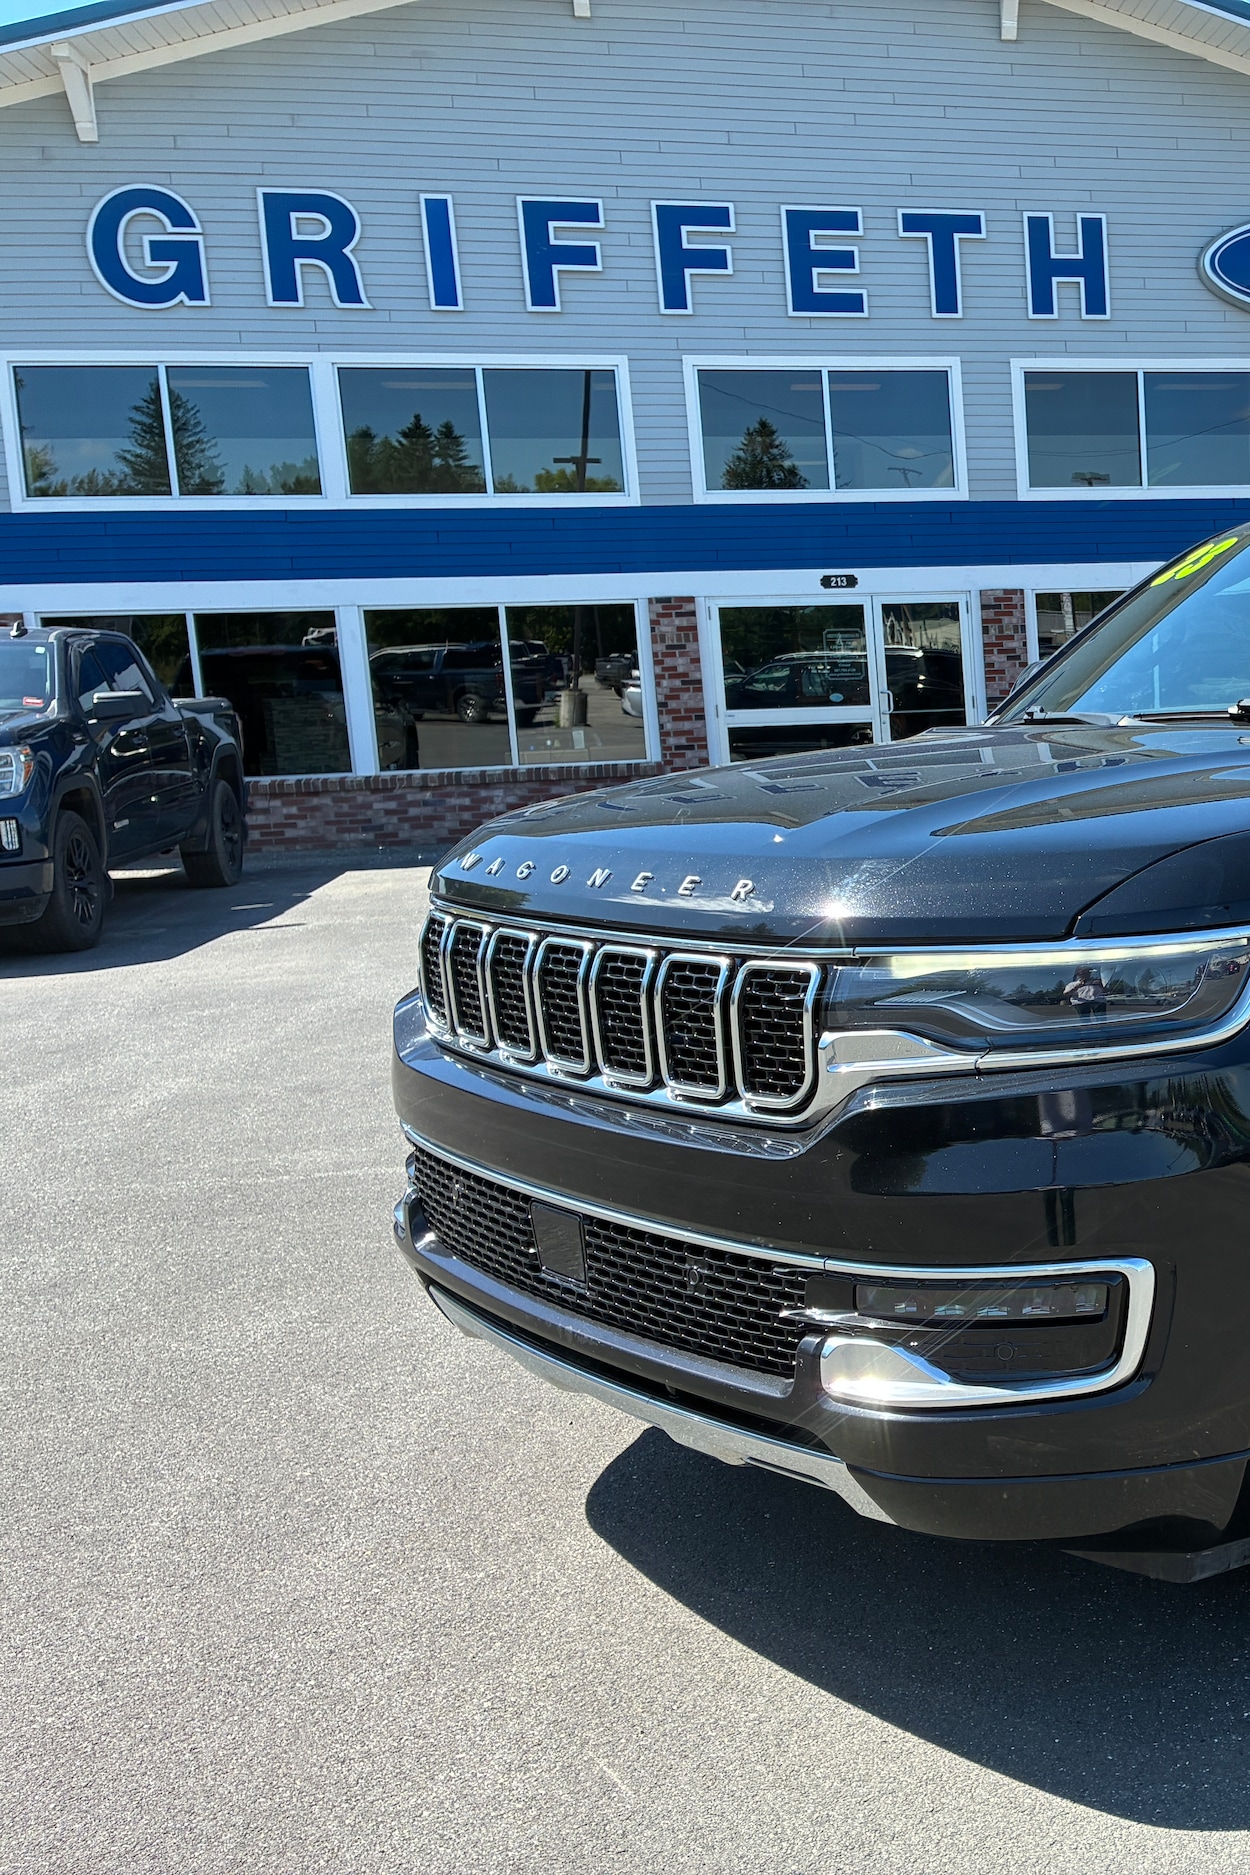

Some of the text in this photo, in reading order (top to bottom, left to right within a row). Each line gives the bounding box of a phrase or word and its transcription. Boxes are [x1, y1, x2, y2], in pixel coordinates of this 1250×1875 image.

[86, 183, 1111, 320] GRIFFETH
[830, 576, 847, 587] 213
[458, 851, 754, 902] WAGONEER
